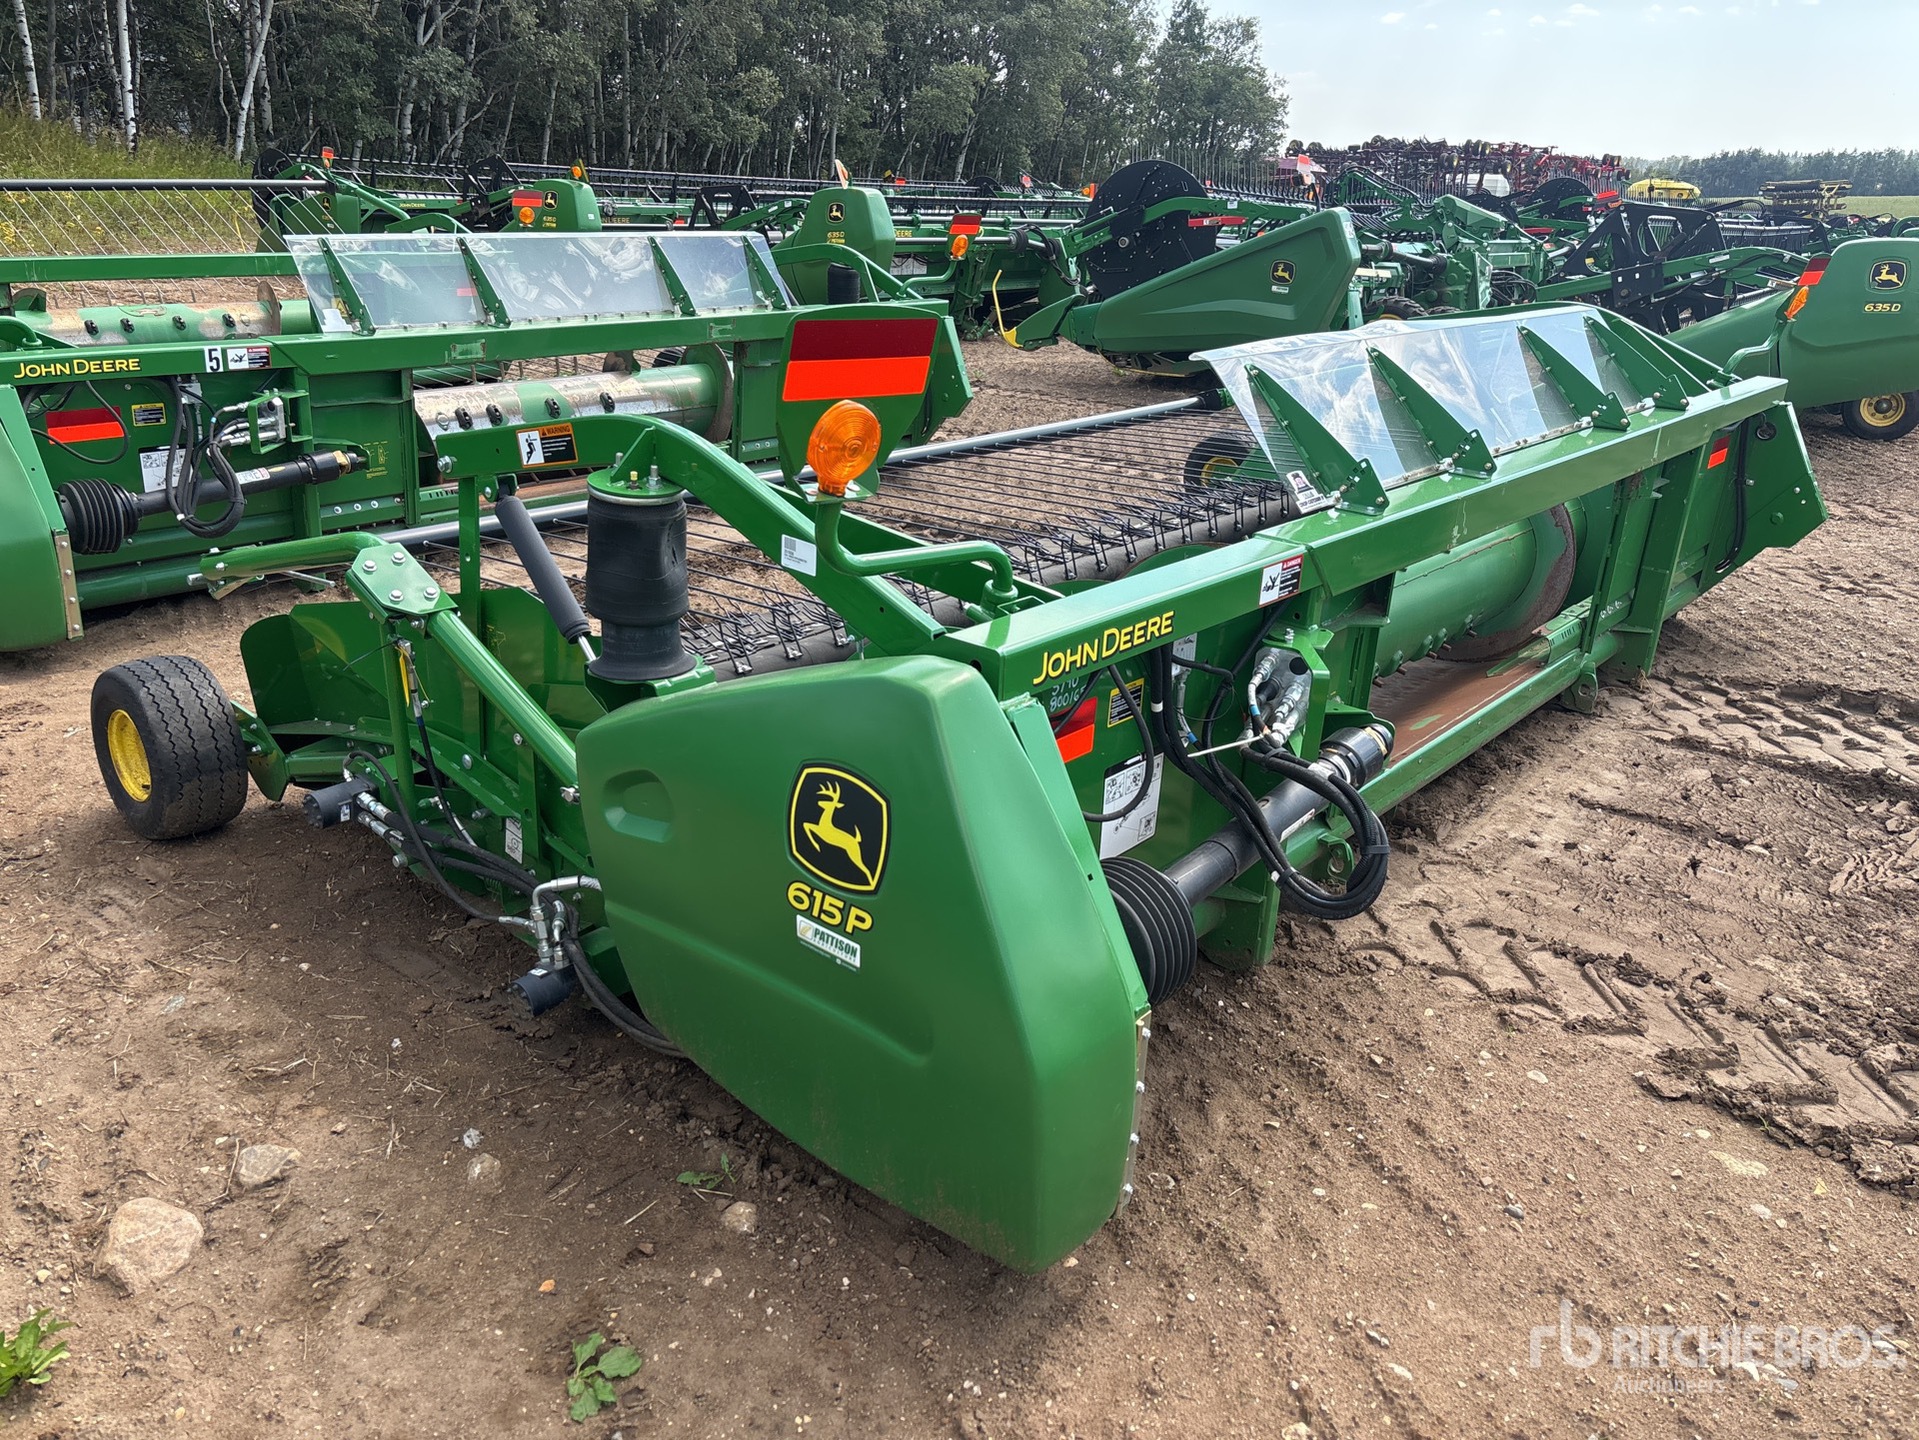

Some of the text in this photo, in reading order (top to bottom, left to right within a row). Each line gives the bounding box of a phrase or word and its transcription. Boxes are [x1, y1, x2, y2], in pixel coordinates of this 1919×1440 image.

[1864, 303, 1902, 312] 635D
[13, 358, 142, 379] JOHN DEERE
[207, 348, 221, 372] 5
[1032, 637, 1100, 686] JOHN
[1101, 610, 1175, 659] DEERE
[786, 880, 874, 935] 615P
[813, 927, 859, 959] PATTISON
